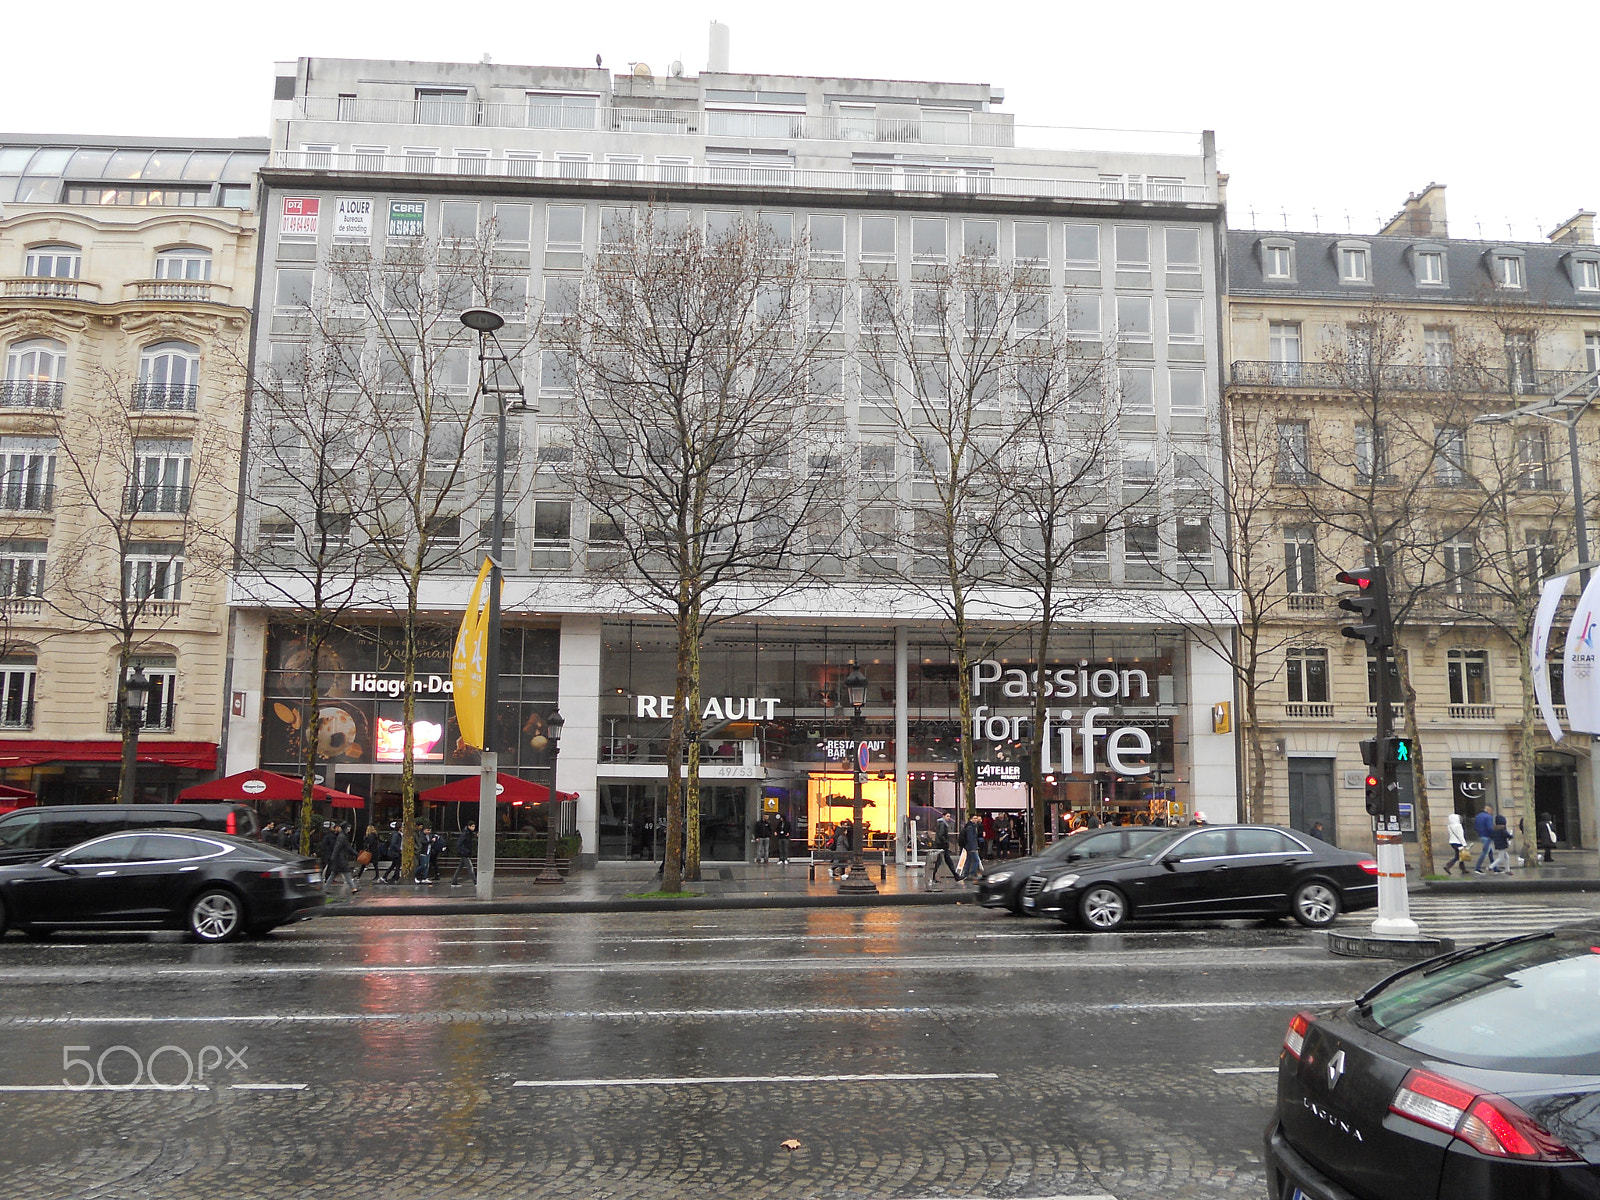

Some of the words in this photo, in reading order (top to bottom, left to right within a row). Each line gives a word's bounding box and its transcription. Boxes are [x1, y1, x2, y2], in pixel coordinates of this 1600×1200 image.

[339, 201, 344, 213] A
[347, 201, 370, 214] LOUER
[392, 204, 423, 213] CBRE
[346, 224, 367, 234] standing
[972, 660, 1150, 697] Passion
[351, 674, 453, 697] Häagn-Da
[637, 695, 780, 720] REAULT
[827, 740, 885, 750] RESTAANT
[972, 706, 1028, 741] for
[1041, 707, 1152, 775] life
[827, 749, 846, 757] BAR
[718, 767, 753, 776] 49/53
[977, 764, 1020, 777] L'ATELIER
[1463, 782, 1486, 790] LCL
[1304, 1097, 1362, 1141] LAGUNA
